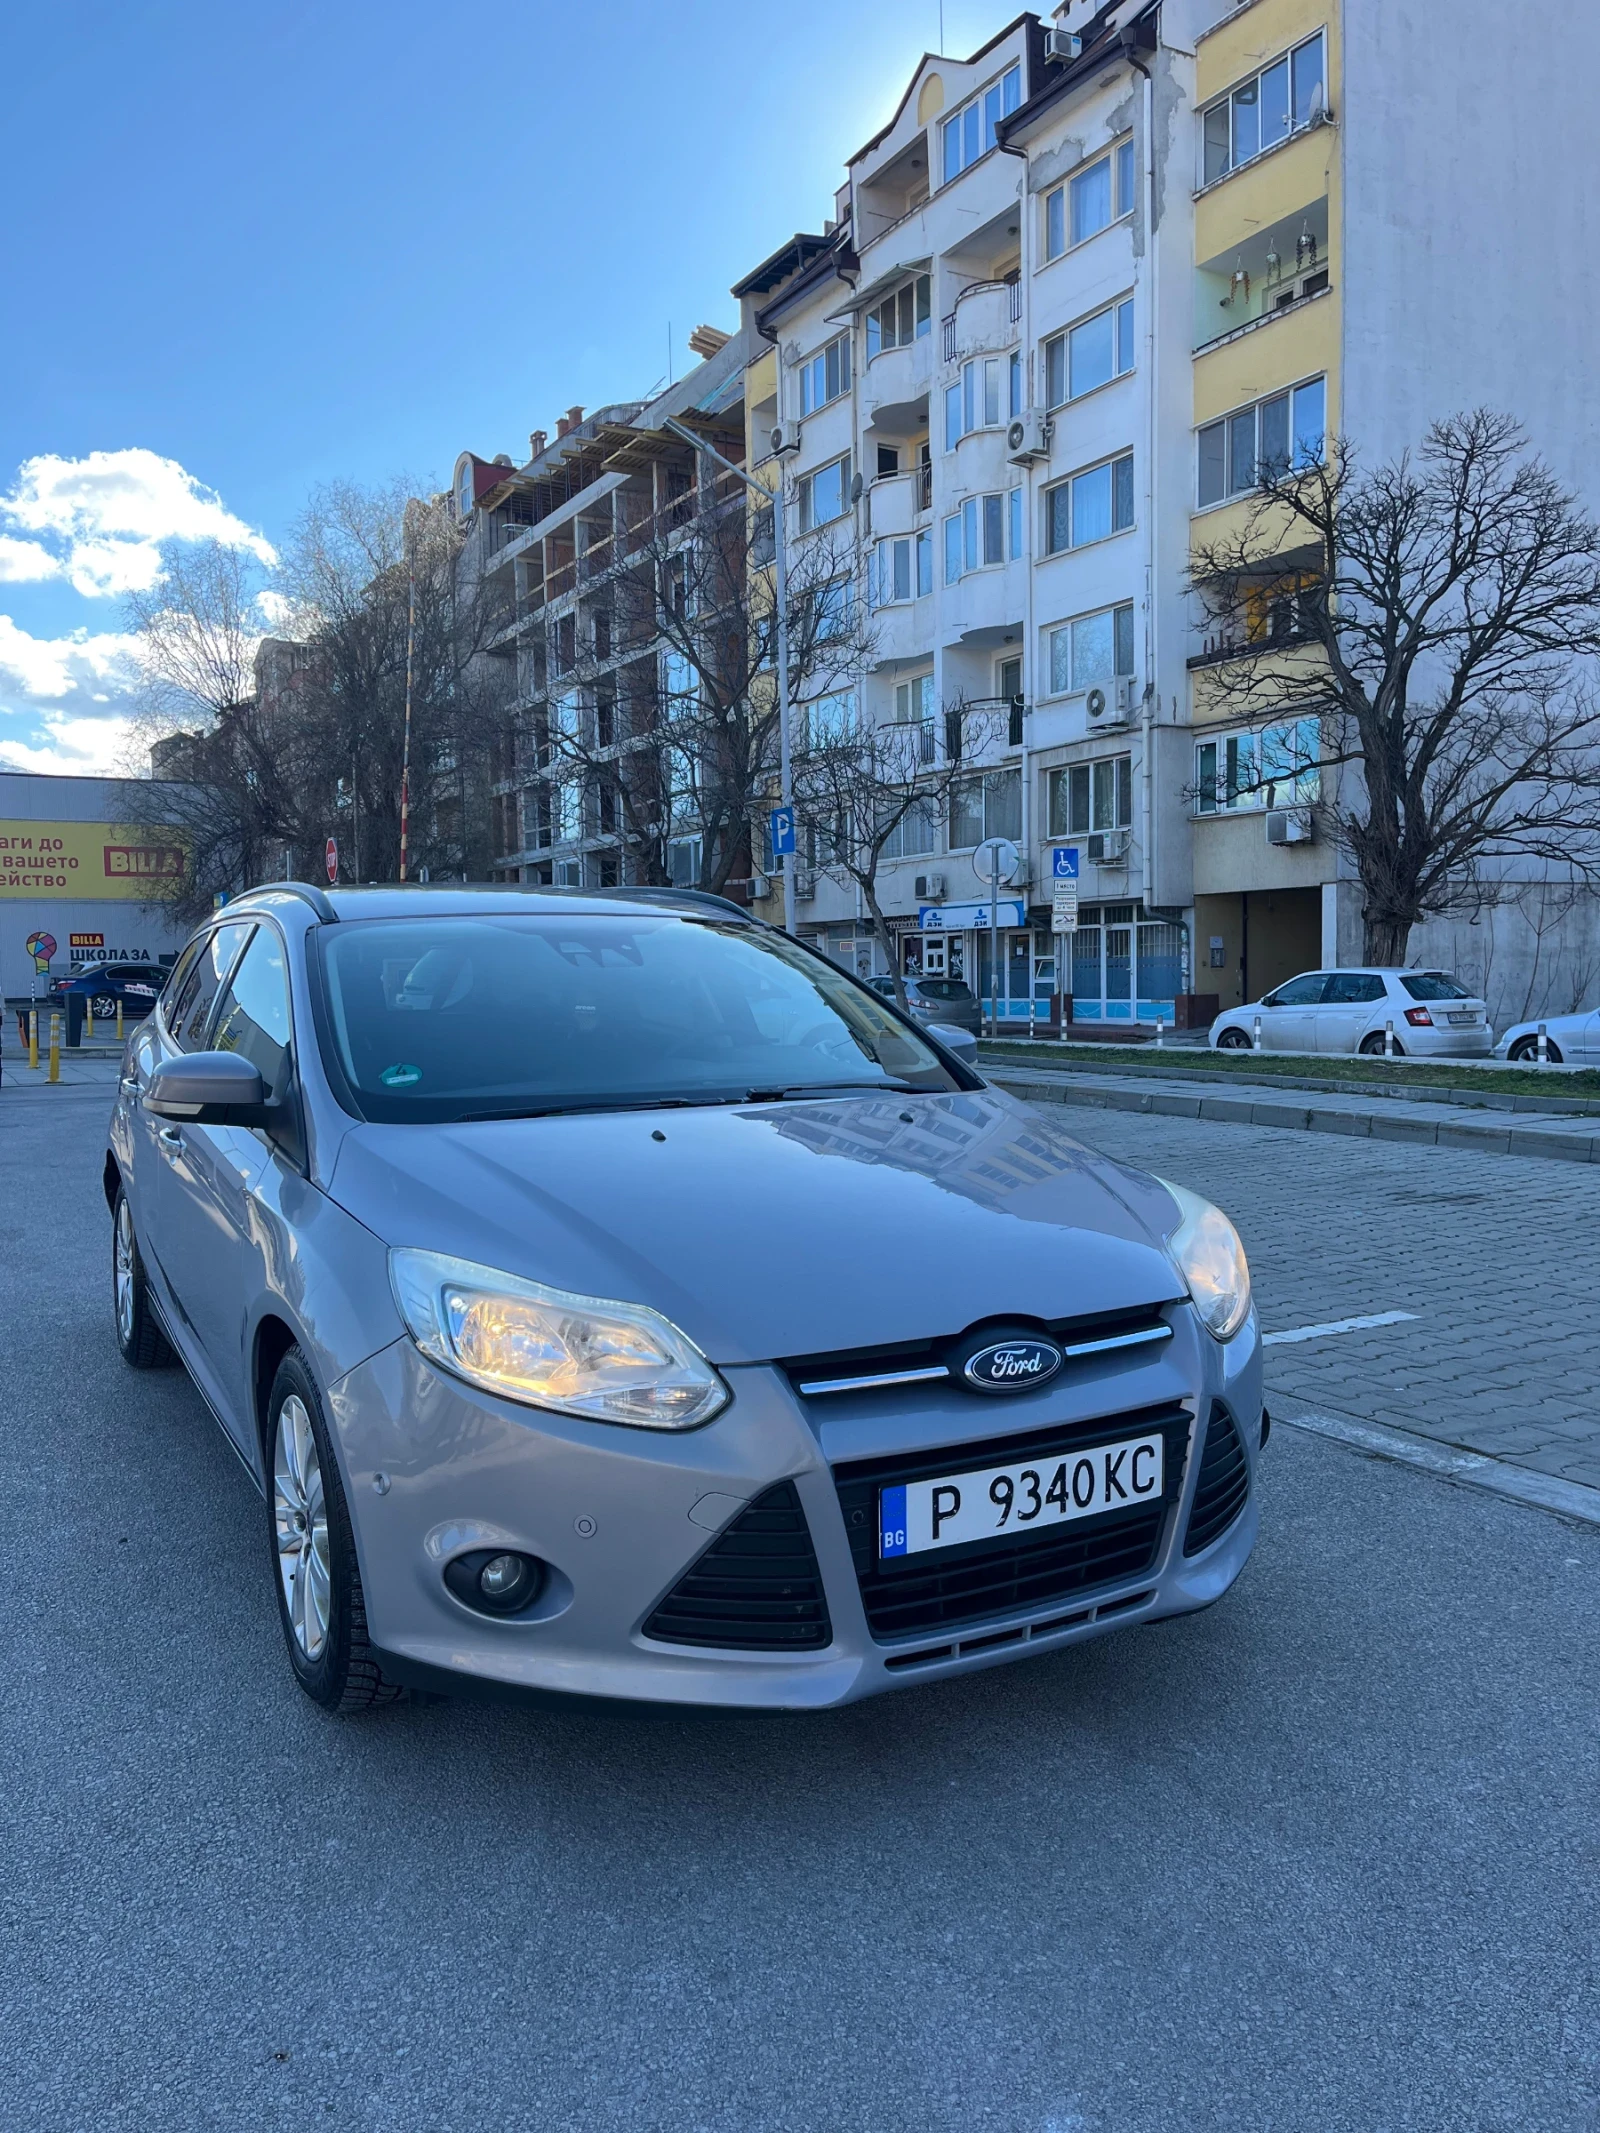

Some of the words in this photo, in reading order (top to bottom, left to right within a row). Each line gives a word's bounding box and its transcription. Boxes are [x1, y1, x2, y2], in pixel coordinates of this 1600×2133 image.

[777, 813, 790, 849] P
[39, 838, 63, 852] до
[2, 856, 79, 869] вашето
[109, 851, 179, 873] BILLA
[0, 870, 67, 887] ейство
[72, 936, 102, 945] BILLA
[991, 1348, 1042, 1379] Ford
[932, 1485, 961, 1540] P
[989, 1458, 1095, 1527] 9340
[1105, 1444, 1155, 1503] KC
[884, 1530, 905, 1549] BG
